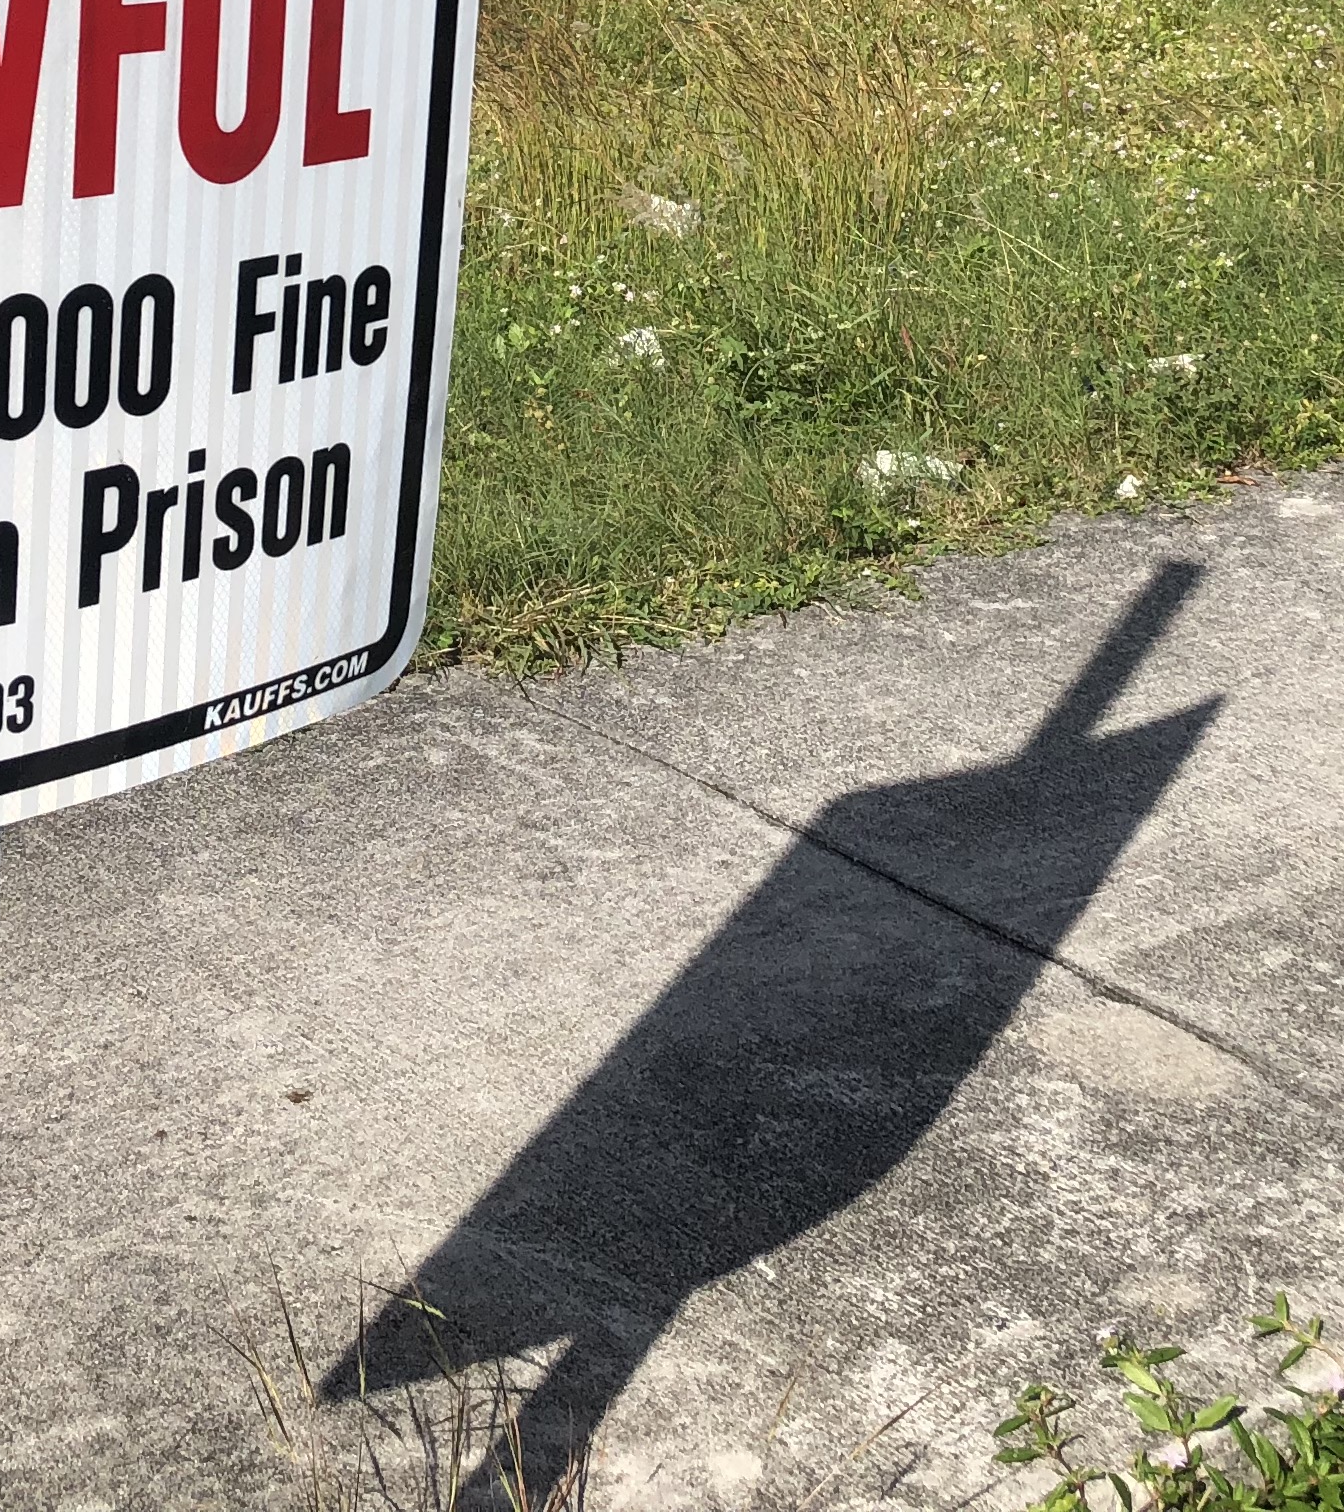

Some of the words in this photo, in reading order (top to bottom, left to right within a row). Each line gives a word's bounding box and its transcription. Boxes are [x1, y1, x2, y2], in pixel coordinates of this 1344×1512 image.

[232, 253, 391, 394] Fine
[79, 443, 350, 608] Prison
[203, 650, 370, 731] KAUFFS.COM
